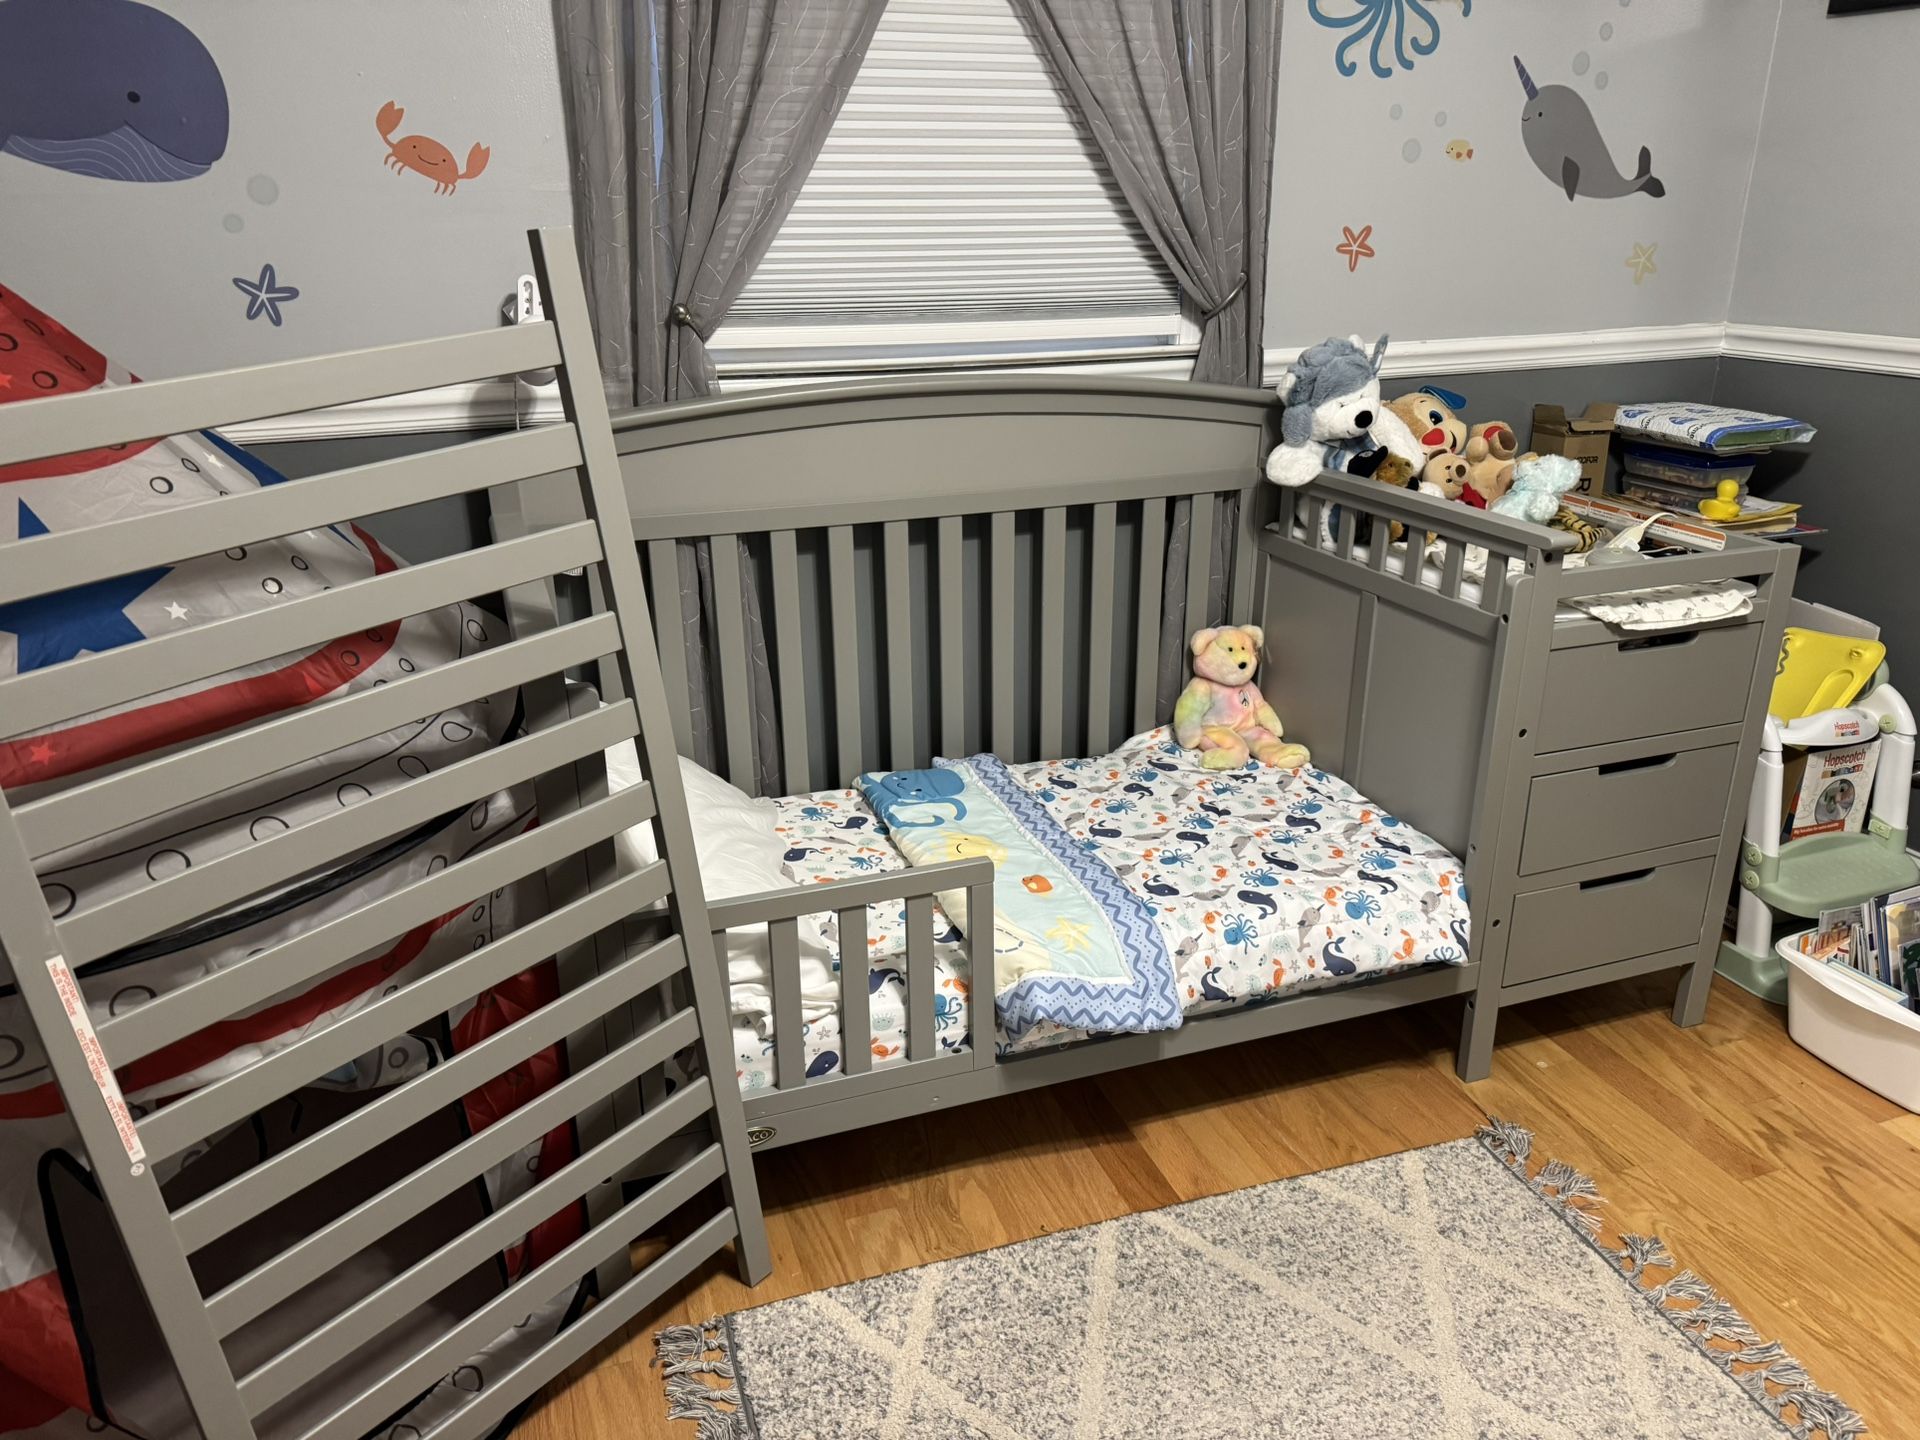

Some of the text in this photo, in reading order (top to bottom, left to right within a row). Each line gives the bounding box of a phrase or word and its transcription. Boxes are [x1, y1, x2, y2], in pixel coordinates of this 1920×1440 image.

[1834, 720, 1860, 731] Hopscotch
[1824, 749, 1866, 767] Hopscotch
[50, 963, 60, 977] THIS
[59, 984, 68, 996] THE
[64, 997, 76, 1016] INSIDE
[82, 1042, 91, 1054] EST
[748, 1131, 769, 1143] CO
